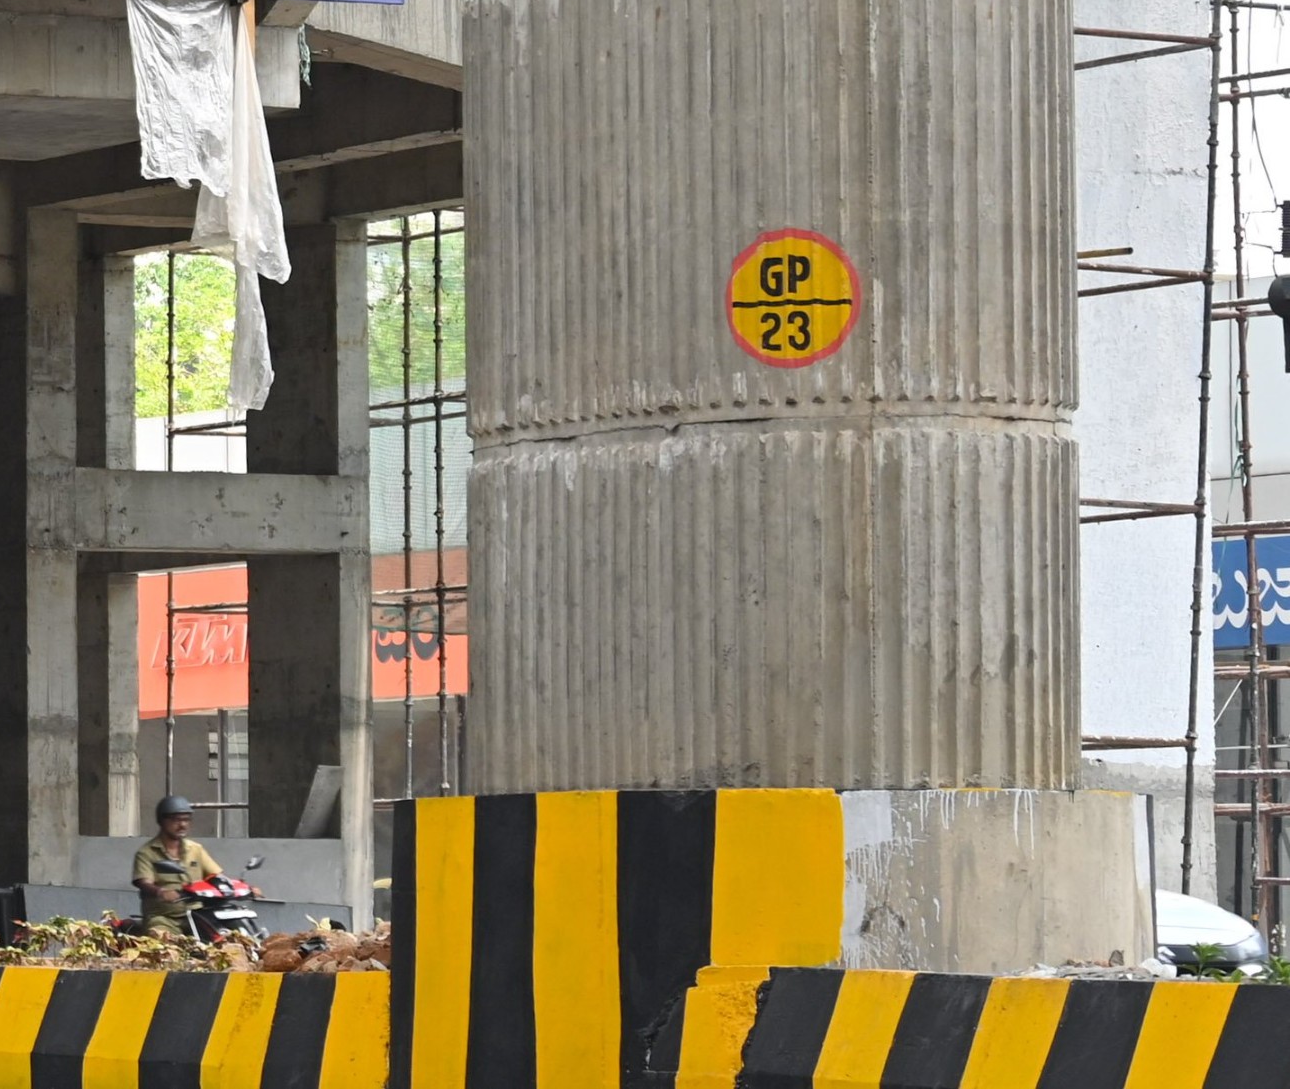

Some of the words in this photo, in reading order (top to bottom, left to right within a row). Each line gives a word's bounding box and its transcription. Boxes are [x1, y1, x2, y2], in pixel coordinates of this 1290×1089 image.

[760, 254, 811, 297] GP
[760, 311, 811, 351] 23
[151, 614, 248, 668] KTM
